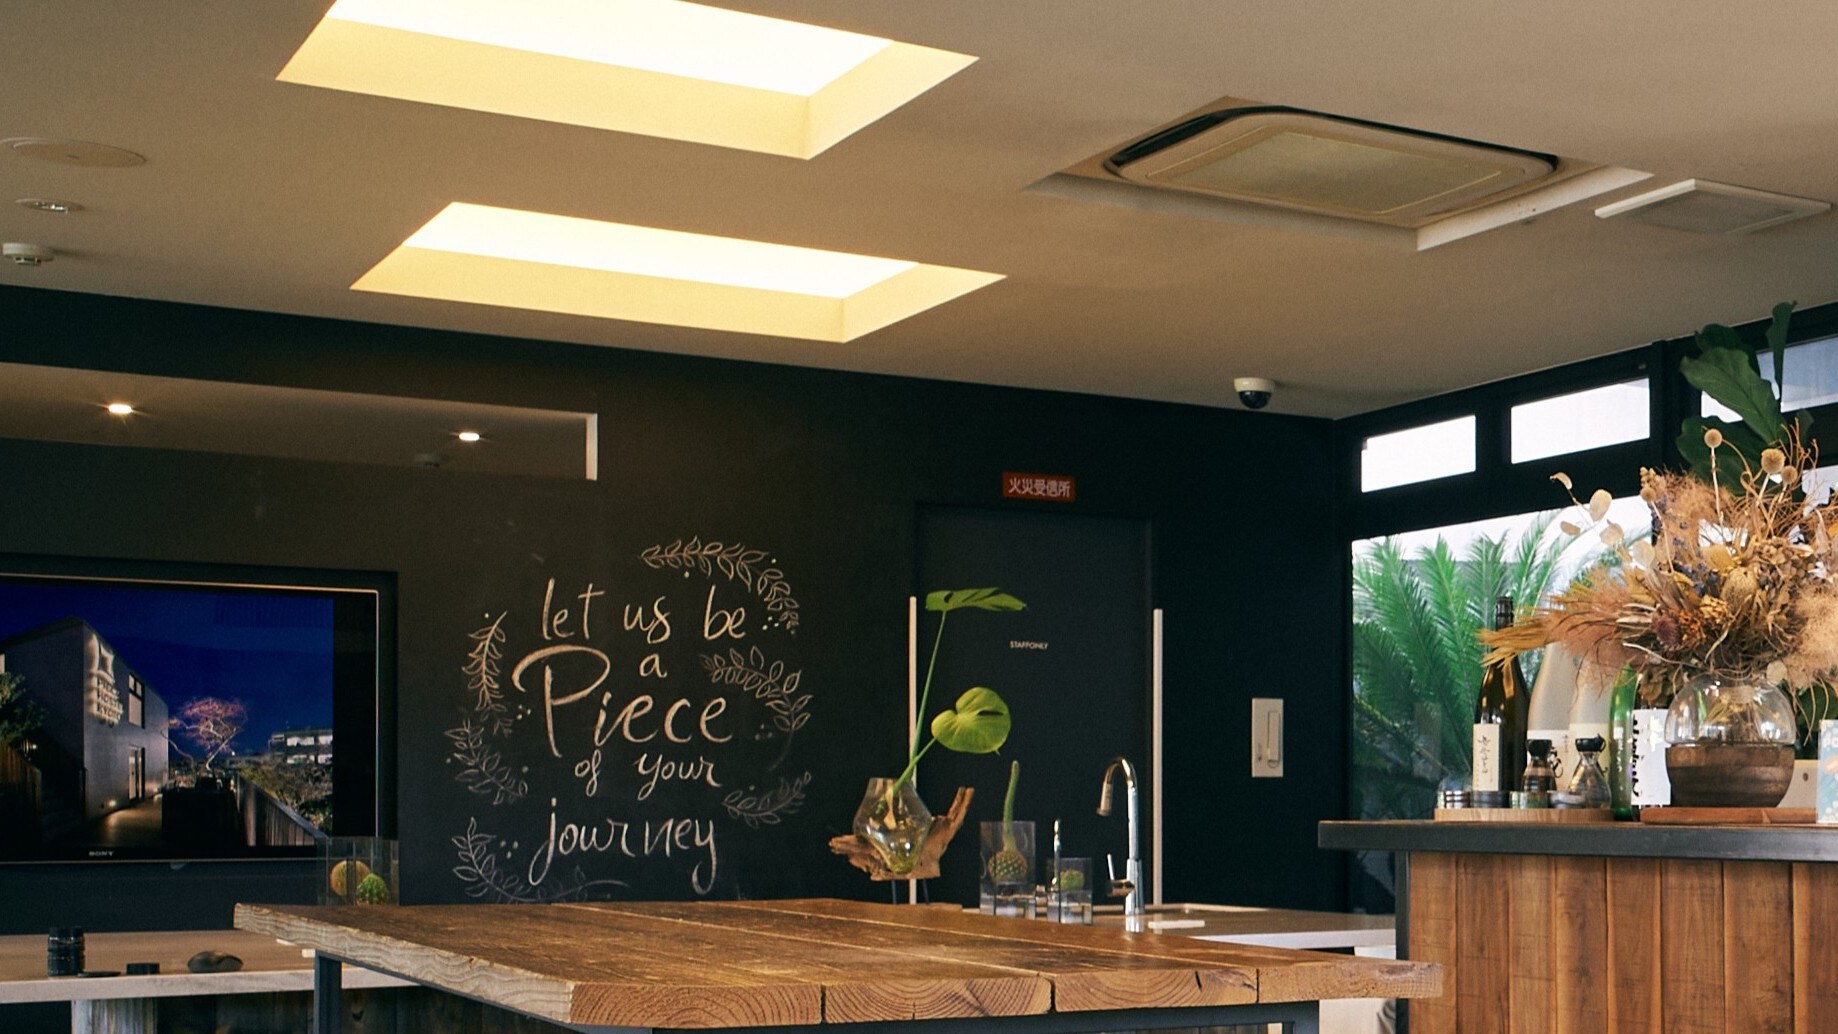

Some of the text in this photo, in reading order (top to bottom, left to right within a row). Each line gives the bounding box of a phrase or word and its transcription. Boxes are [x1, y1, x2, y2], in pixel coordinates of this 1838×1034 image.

[542, 578, 746, 644] let us be
[639, 653, 667, 678] a
[511, 645, 733, 758] Piece
[575, 749, 722, 800] of your
[528, 797, 717, 894] journey
